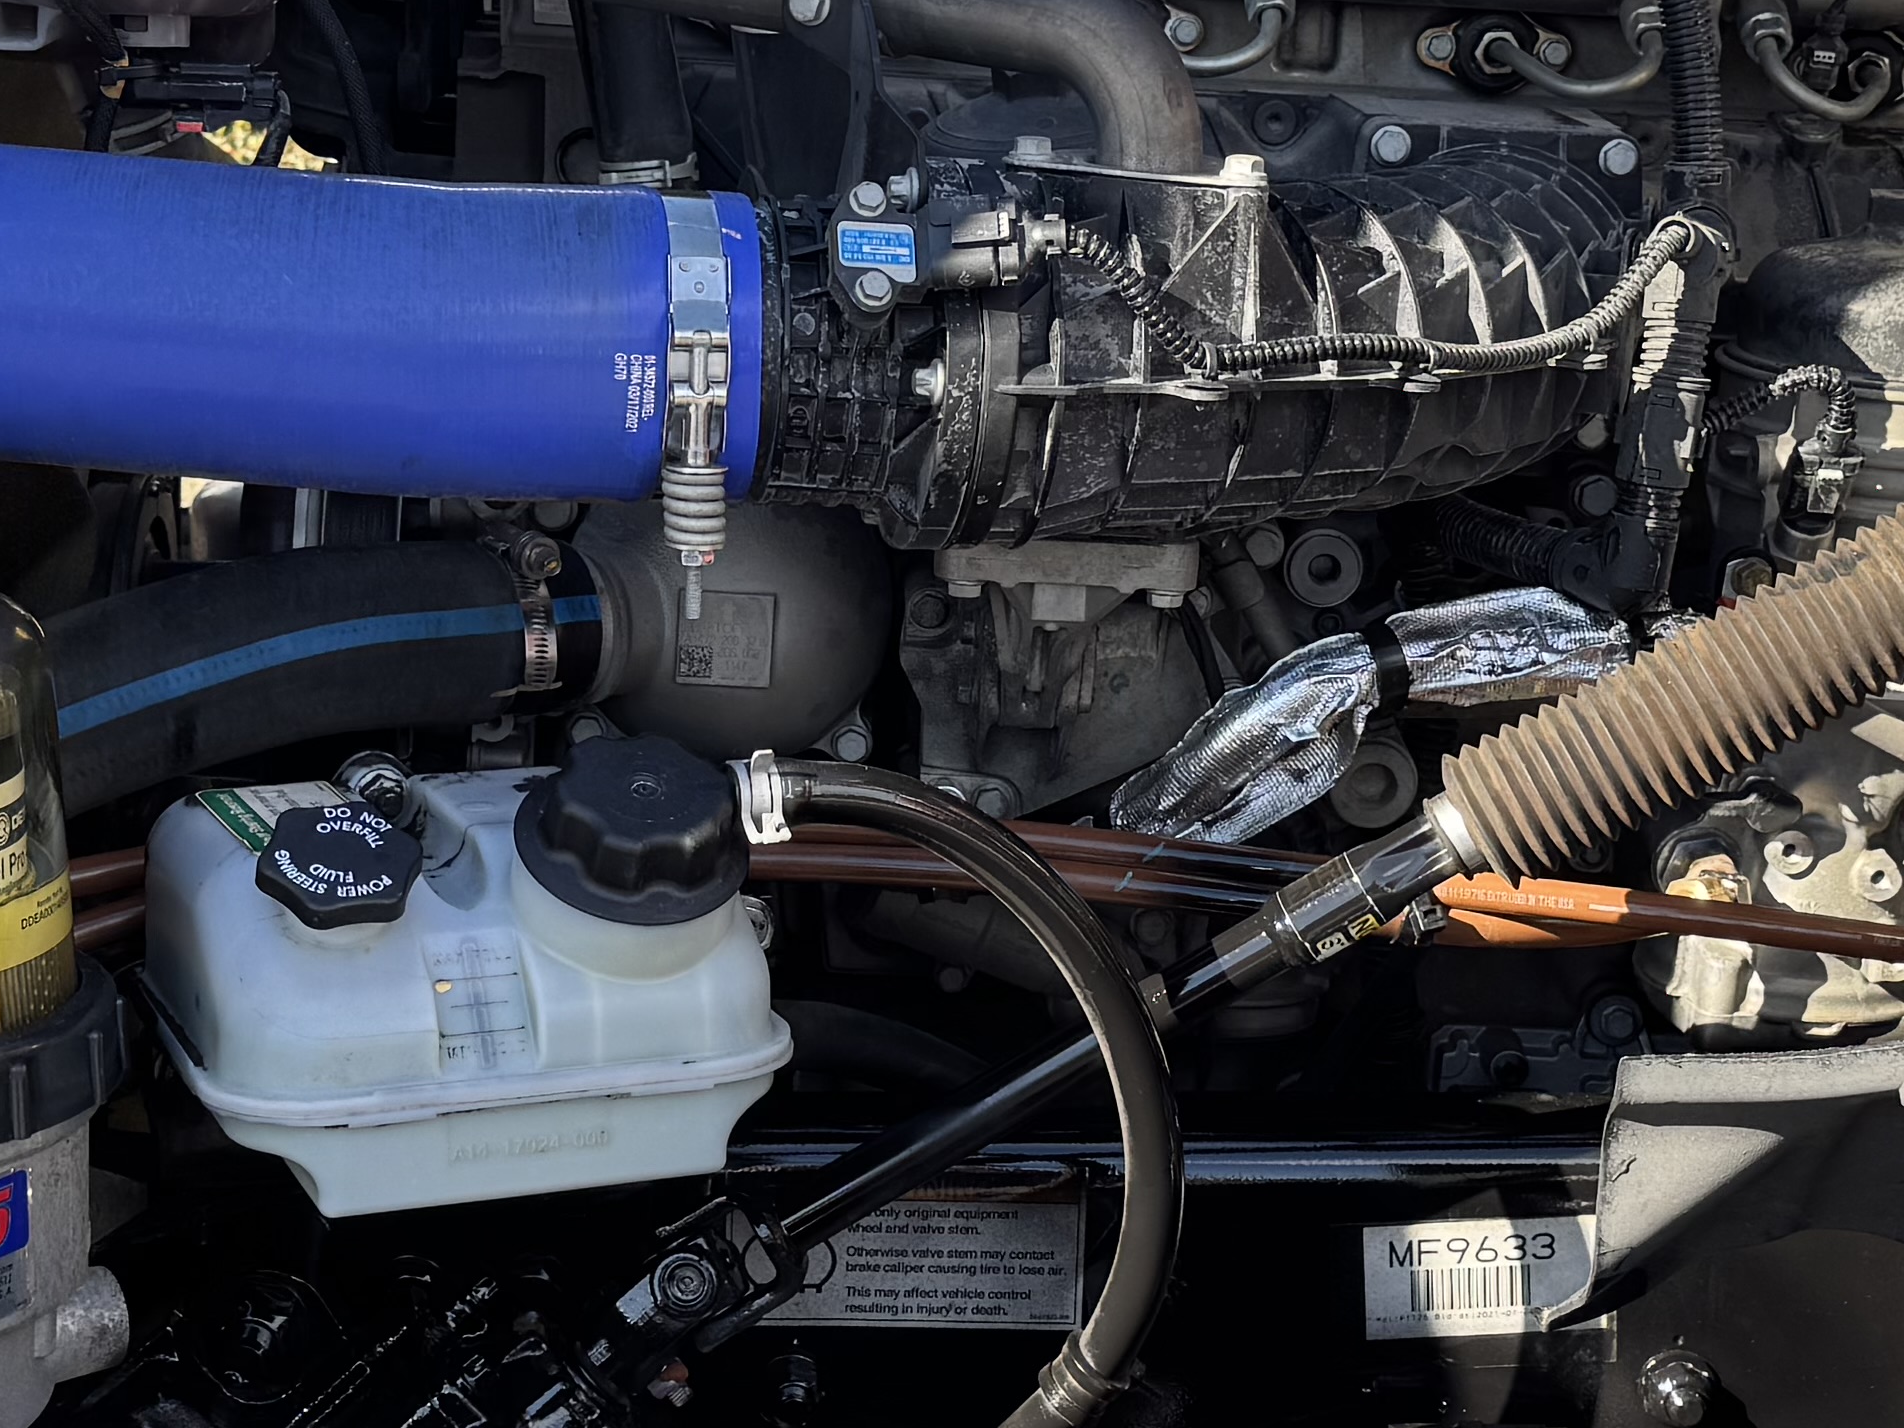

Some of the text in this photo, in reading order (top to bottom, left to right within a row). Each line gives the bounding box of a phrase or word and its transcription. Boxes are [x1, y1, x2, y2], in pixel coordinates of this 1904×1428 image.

[613, 352, 628, 380] GH70
[625, 354, 643, 433] CHINA 03/17/2021
[323, 806, 393, 833] DO NOT
[315, 820, 385, 850] OVERFILL
[9, 850, 26, 877] Pro
[274, 848, 393, 899] POWER STEERING
[309, 863, 355, 885] FLUID
[1527, 894, 1536, 906] IN
[1537, 896, 1557, 909] THE
[875, 1207, 1019, 1223] only original equipment
[847, 1223, 982, 1236] wheel and valve stem.
[846, 1246, 1055, 1263] Otherwise valve stem may contact
[1388, 1232, 1556, 1268] MF9633
[846, 1261, 1068, 1277] brake caliper causing tire to lose air.
[846, 1286, 1032, 1301] This may affect vehicle control
[844, 1303, 1009, 1319] resulting in injury or death.
